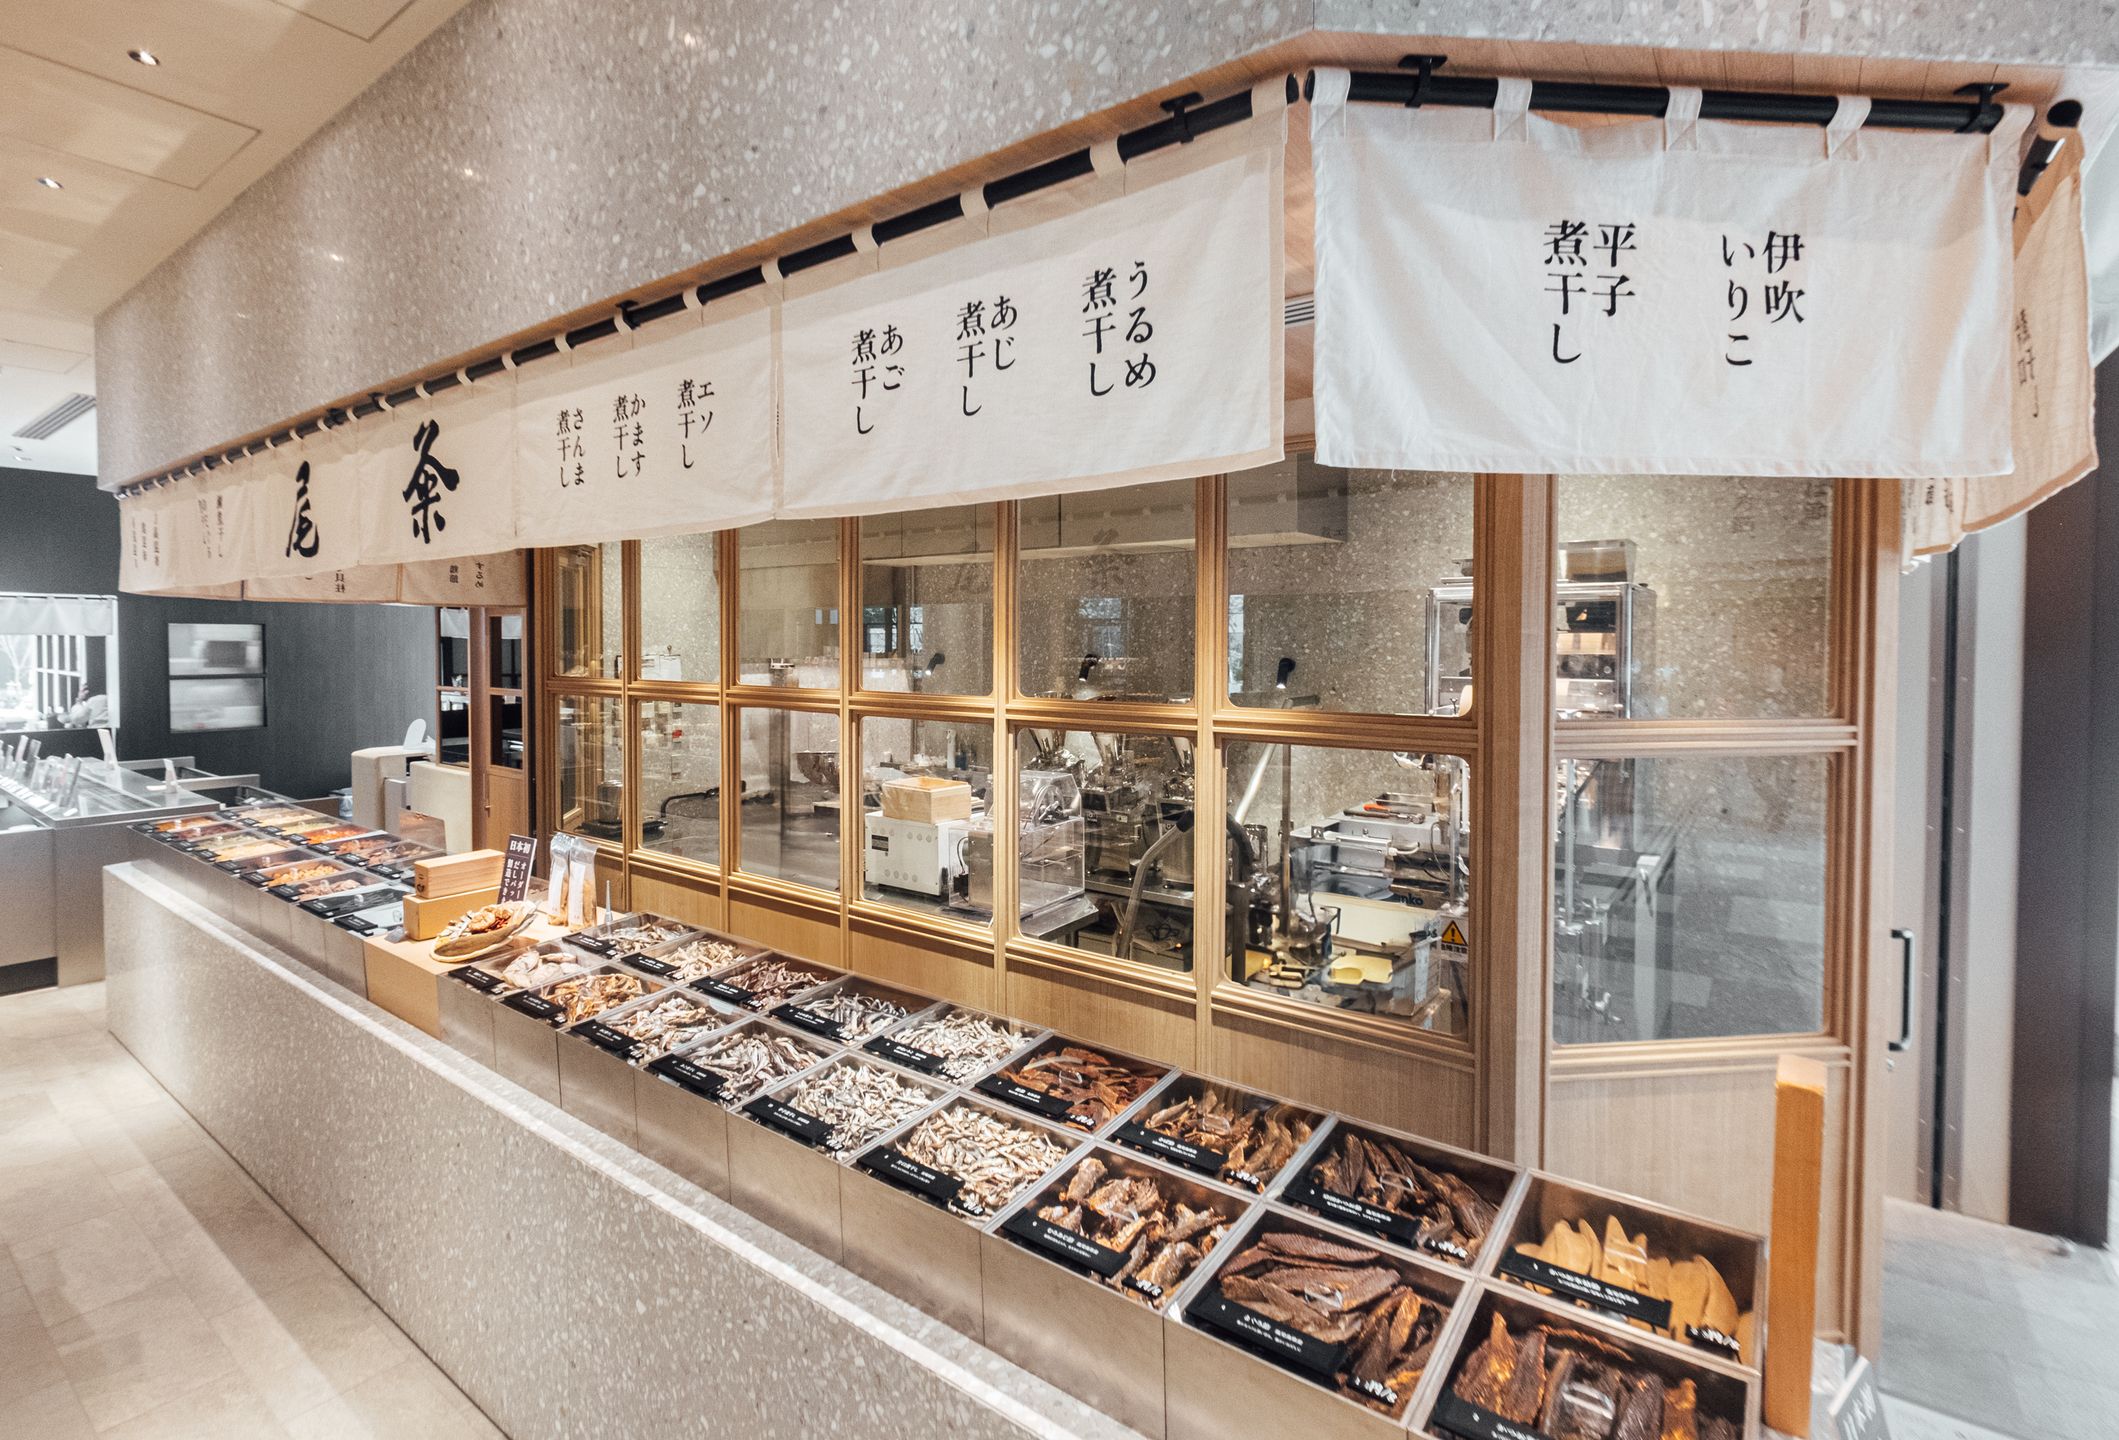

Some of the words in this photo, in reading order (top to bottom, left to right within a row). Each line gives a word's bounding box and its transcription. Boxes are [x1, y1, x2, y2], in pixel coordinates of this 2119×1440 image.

[1543, 219, 1589, 364] 煮干し
[1592, 222, 1637, 317] 平子
[1722, 234, 1755, 366] いりこ
[1762, 230, 1805, 324] 伊吹
[880, 324, 905, 391] あご
[956, 300, 986, 416] 煮干し
[990, 295, 1018, 371] あじ
[1081, 267, 1117, 397] 煮干し
[1124, 260, 1157, 389] うるめ
[697, 382, 715, 434] エソ
[851, 328, 877, 435] 煮干し
[557, 409, 571, 488] 煮干し
[573, 408, 585, 486] さんま
[613, 395, 629, 478] 煮干し
[631, 393, 646, 477] かます
[677, 379, 695, 469] 煮干し
[509, 840, 532, 854] 日本初
[509, 860, 521, 902] だしパッ
[516, 861, 527, 899] オーダー
